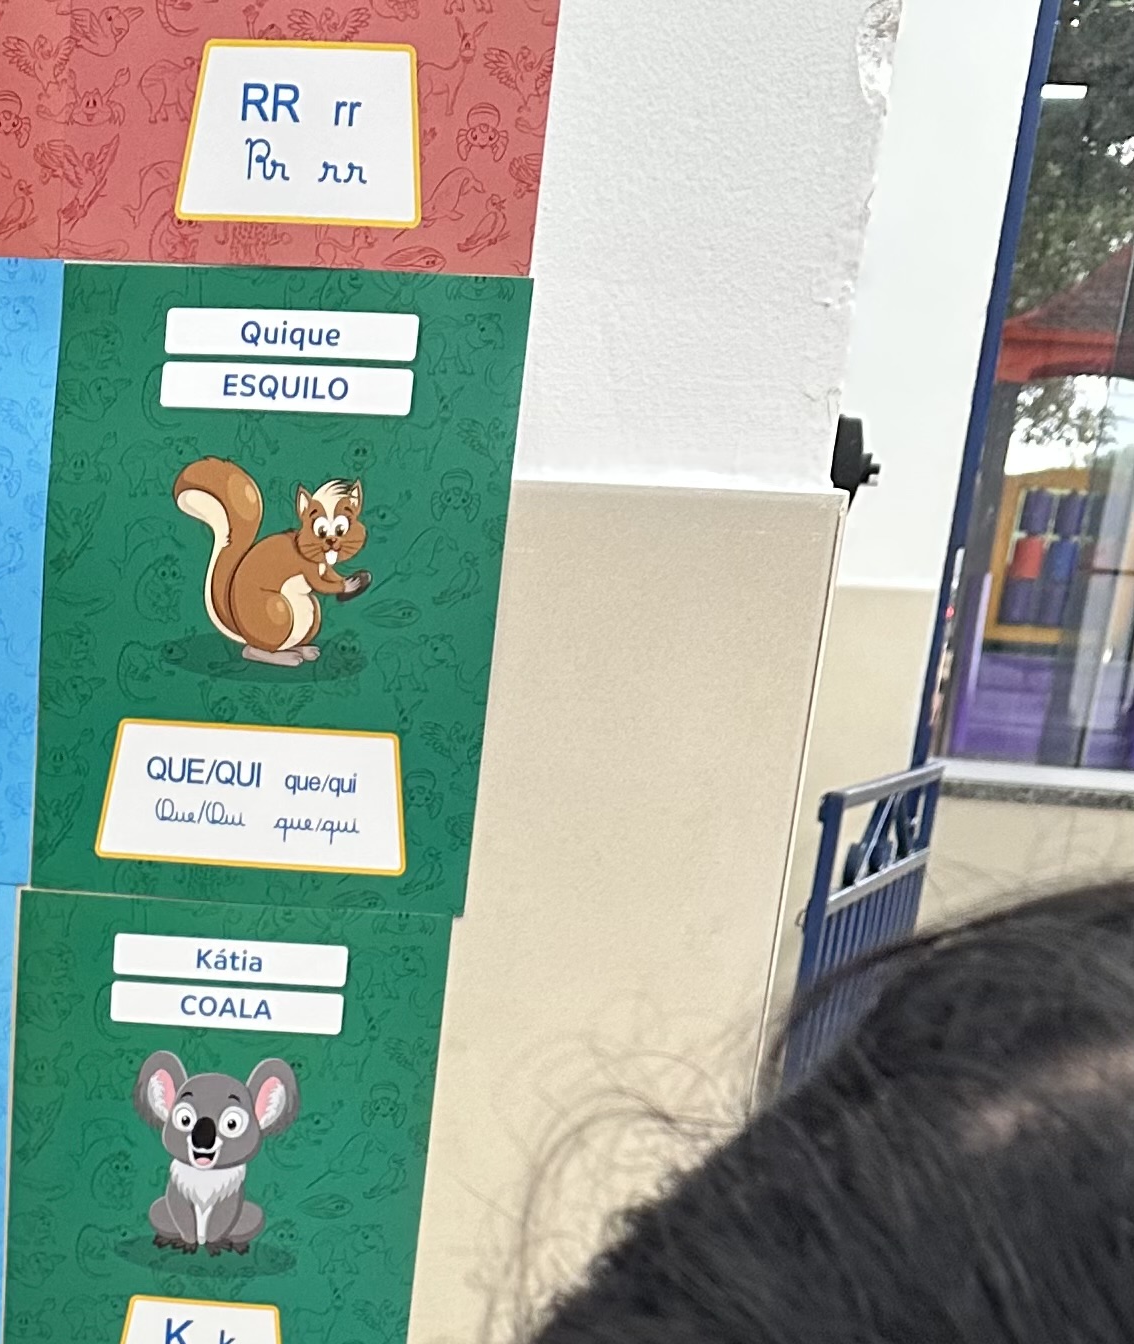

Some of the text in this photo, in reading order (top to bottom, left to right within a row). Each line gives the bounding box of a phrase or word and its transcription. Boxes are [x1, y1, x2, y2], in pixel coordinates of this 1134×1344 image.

[240, 82, 363, 128] RR rr
[240, 320, 341, 352] Quique
[222, 373, 349, 401] ESQUILO
[146, 755, 358, 798] QUE/QUI que/qui
[196, 948, 263, 973] Kátia
[180, 994, 273, 1021] COALA
